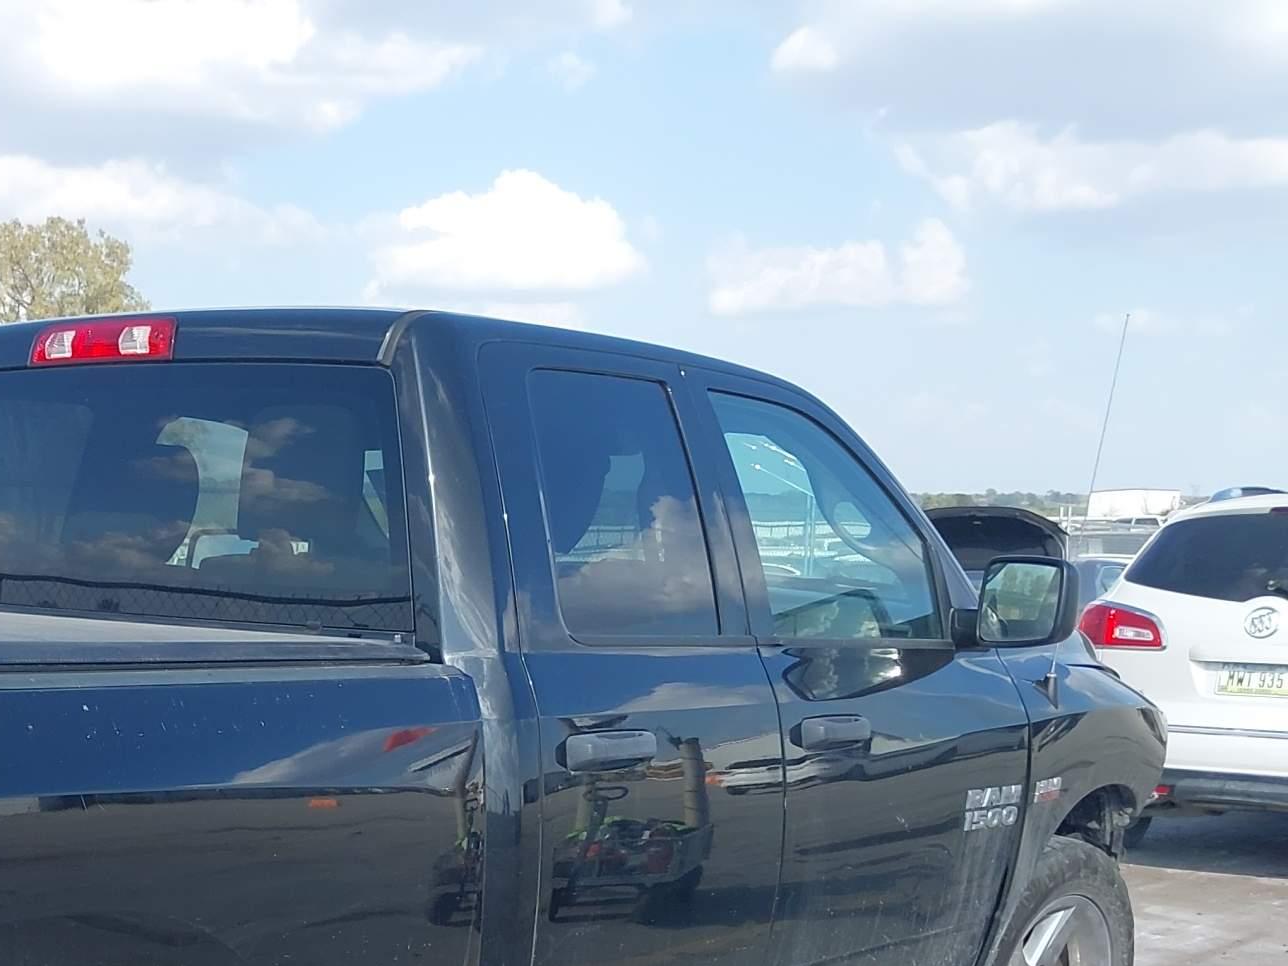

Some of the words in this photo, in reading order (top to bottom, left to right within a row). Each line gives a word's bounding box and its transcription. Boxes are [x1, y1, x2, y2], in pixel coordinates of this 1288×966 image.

[1258, 672, 1284, 689] 935
[965, 785, 1023, 809] RAM
[963, 805, 1019, 832] 1500
